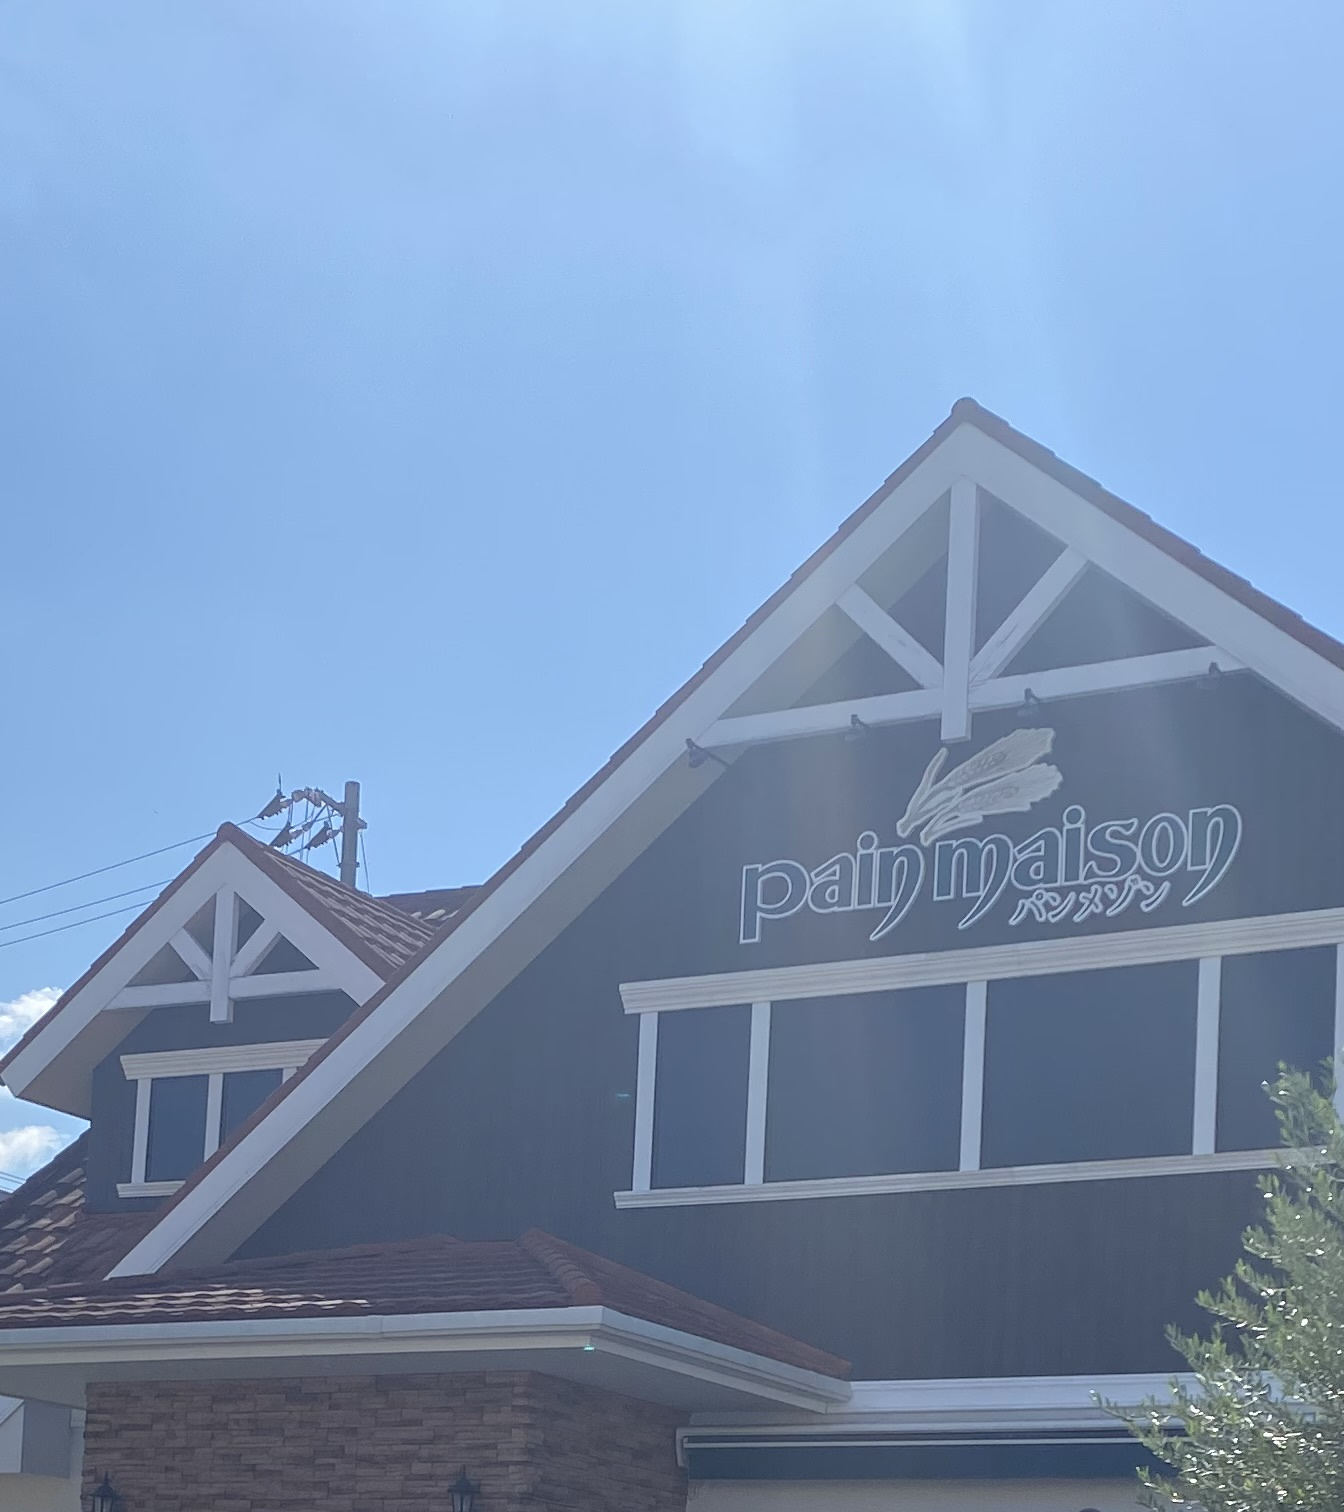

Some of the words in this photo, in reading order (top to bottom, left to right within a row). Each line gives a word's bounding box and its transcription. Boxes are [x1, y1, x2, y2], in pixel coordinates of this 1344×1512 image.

[739, 830, 926, 944] pain
[933, 804, 1243, 930] maison
[1008, 875, 1172, 925] パンメゾン
